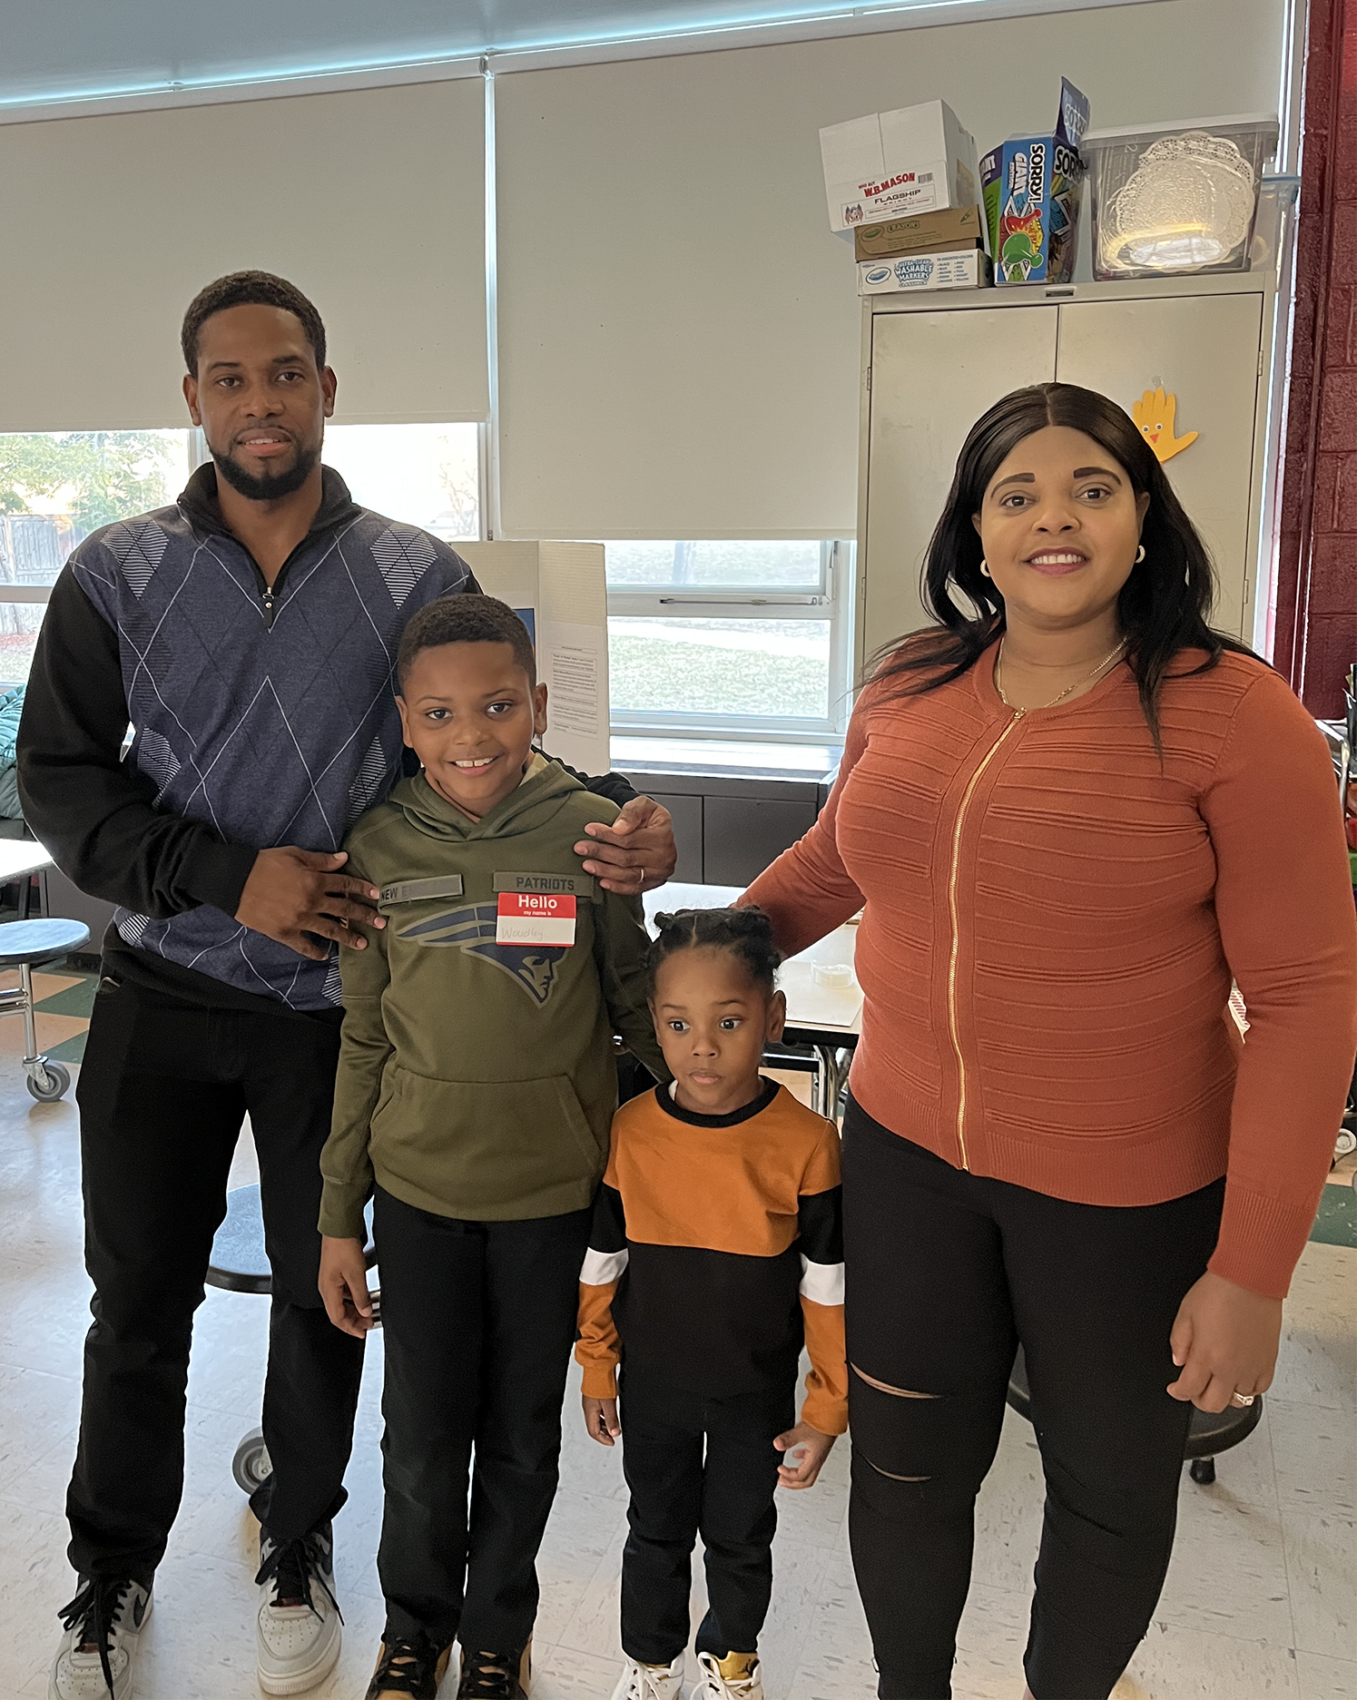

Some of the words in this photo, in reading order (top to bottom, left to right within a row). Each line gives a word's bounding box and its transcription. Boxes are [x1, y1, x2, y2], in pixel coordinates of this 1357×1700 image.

[1013, 152, 1028, 196] GIANT
[1029, 143, 1045, 202] SORRY!
[874, 189, 921, 204] FLAGSHIP
[887, 220, 920, 233] CRAYONS
[894, 263, 933, 275] WASHABLE
[899, 272, 929, 281] MARKERS
[516, 876, 575, 891] PATRIOTS
[380, 886, 399, 901] NEW
[518, 894, 558, 909] Hello
